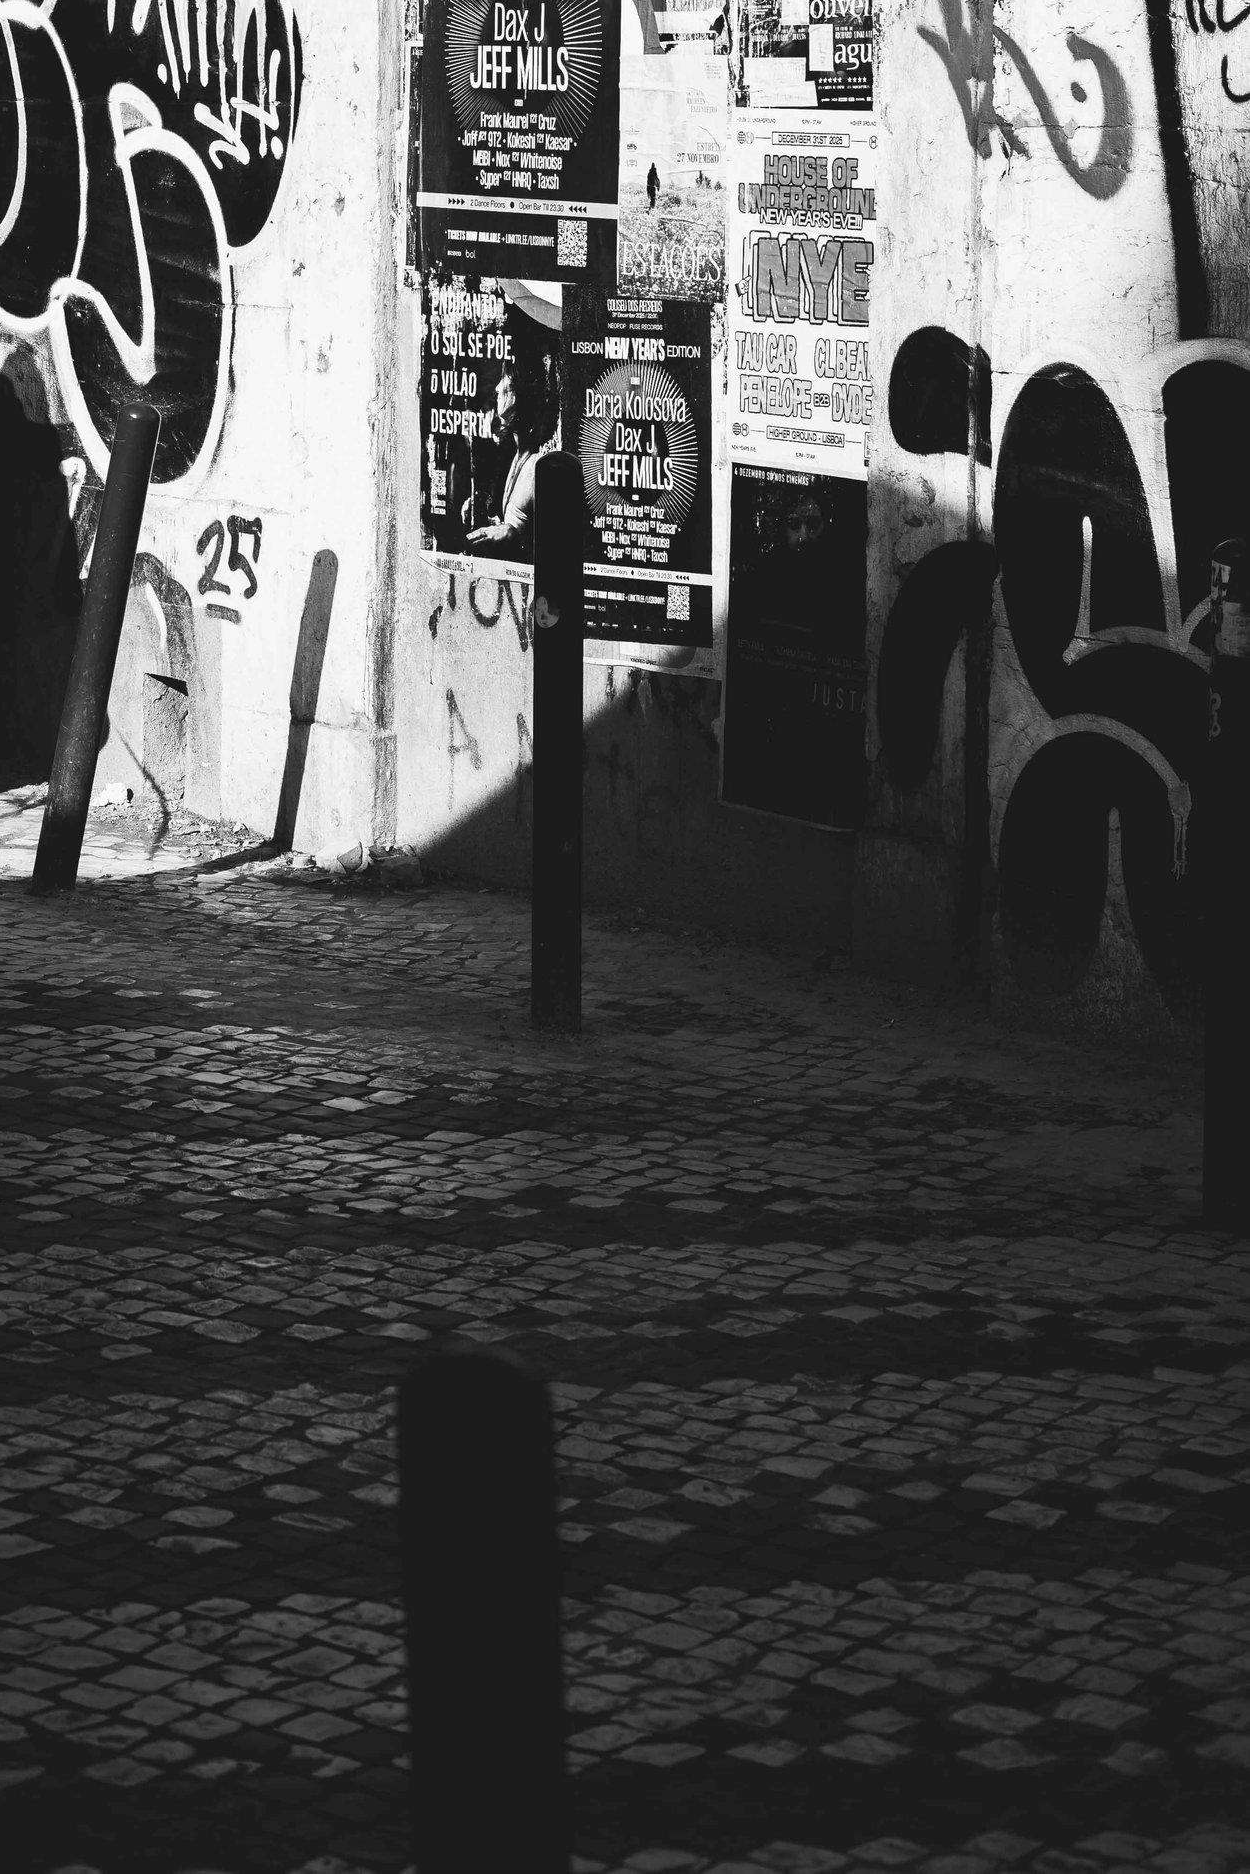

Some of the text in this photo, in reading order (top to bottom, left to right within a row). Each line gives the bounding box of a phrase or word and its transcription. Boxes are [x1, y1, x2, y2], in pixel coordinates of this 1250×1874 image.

[493, 2, 546, 43] Dax J
[469, 45, 569, 92] JEFF MILLS
[834, 43, 873, 71] agu
[480, 111, 502, 128] Frank
[502, 112, 529, 129] Maurel
[538, 114, 557, 131] Cruz
[462, 130, 478, 147] Joff
[507, 132, 536, 149] Kokeshi
[545, 134, 573, 151] Kaesar
[778, 133, 843, 145] DECEMBER 31ST 2025
[495, 151, 511, 168] Nox
[520, 151, 563, 171] Whitenoise
[676, 153, 720, 164] 27 NOVEMBRO
[764, 154, 859, 189] HOUSE OF
[479, 169, 502, 190] Syper
[537, 173, 560, 190] Taxsh
[474, 199, 490, 207] Dance
[490, 200, 506, 208] Floors
[518, 201, 532, 211] Open
[533, 202, 542, 211] Bar
[759, 207, 788, 226] NEW
[790, 208, 831, 228] YEAR'S
[621, 236, 723, 282] ESTAÇÕES
[754, 236, 874, 323] NYE
[628, 299, 639, 312] DOS
[430, 329, 516, 364] O SOL SE PÕE,
[571, 336, 701, 362] LISBON NEW YEAR'S EDITION
[734, 330, 798, 375] TAU CAR
[441, 367, 478, 398] VILÃO
[585, 388, 686, 423] Daria Kolosova
[739, 373, 812, 420] PENELOPE
[812, 392, 831, 408] B2B
[615, 422, 655, 454] Dax J
[769, 427, 843, 445] HIGHER GROUND LISBOA
[597, 453, 674, 492] JEFF MILLS
[739, 467, 765, 480] DEZEMBRO
[774, 472, 785, 483] NOS
[786, 473, 809, 487] CINEMAS
[606, 502, 665, 520] Frank Maurel Cruz
[196, 514, 263, 600] 25
[607, 545, 625, 561] Syper
[651, 549, 668, 564] Taxsh
